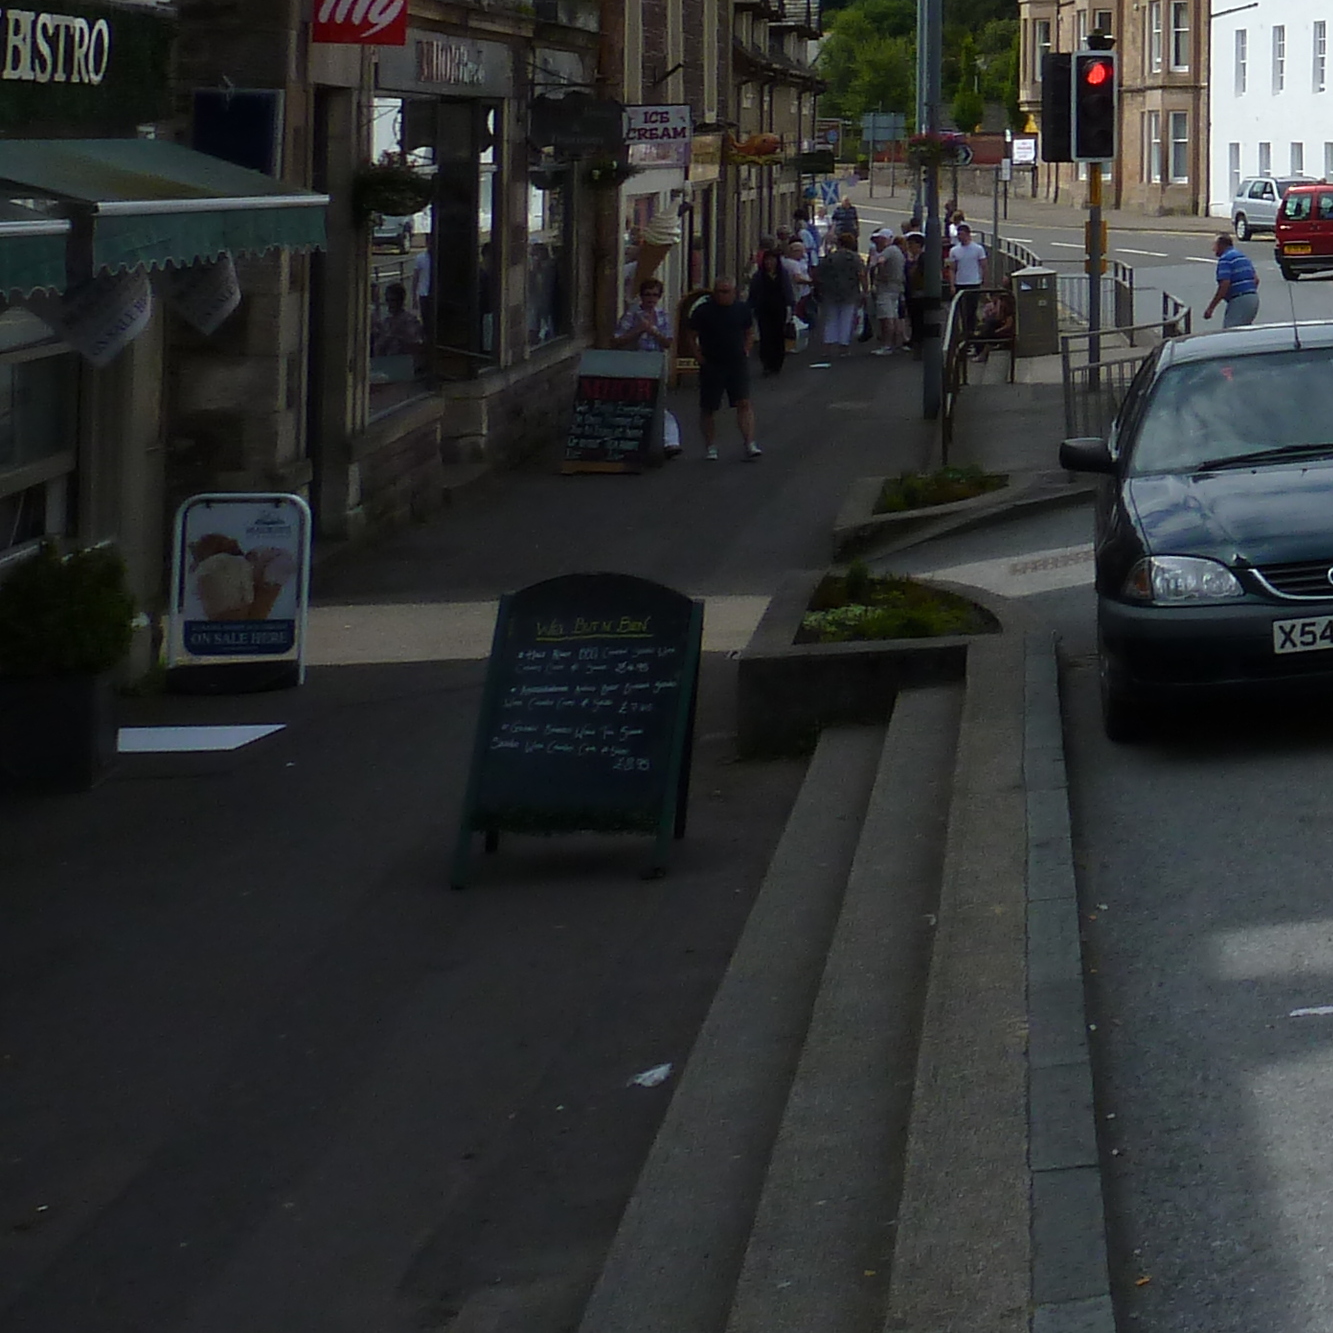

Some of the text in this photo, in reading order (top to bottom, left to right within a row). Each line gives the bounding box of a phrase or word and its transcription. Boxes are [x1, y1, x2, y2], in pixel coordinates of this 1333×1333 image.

[2, 8, 110, 86] BISTRO
[643, 111, 671, 125] ICE
[625, 127, 687, 140] CREAM
[189, 632, 289, 645] ON SALE HERE
